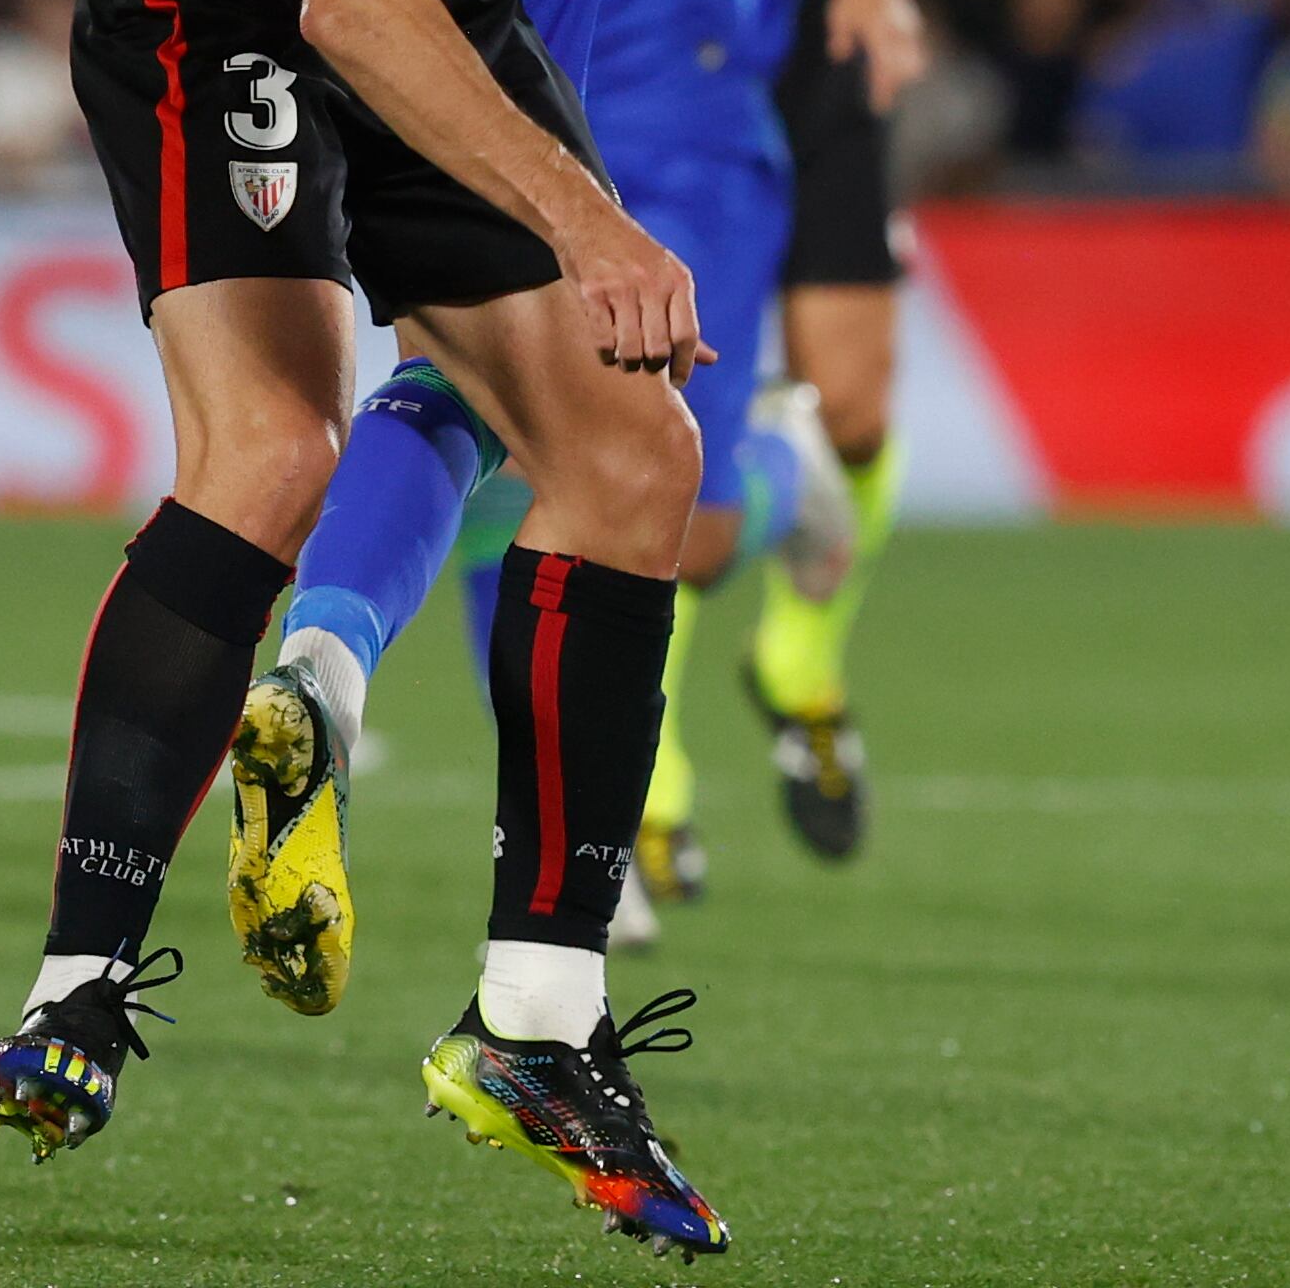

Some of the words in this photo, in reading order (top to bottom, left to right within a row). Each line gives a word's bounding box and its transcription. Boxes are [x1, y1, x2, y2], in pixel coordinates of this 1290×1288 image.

[222, 52, 299, 151] 3
[252, 208, 280, 225] BILBAO
[59, 836, 167, 881] ATHLETI
[80, 856, 147, 886] CLUB
[518, 1055, 555, 1067] COPA
